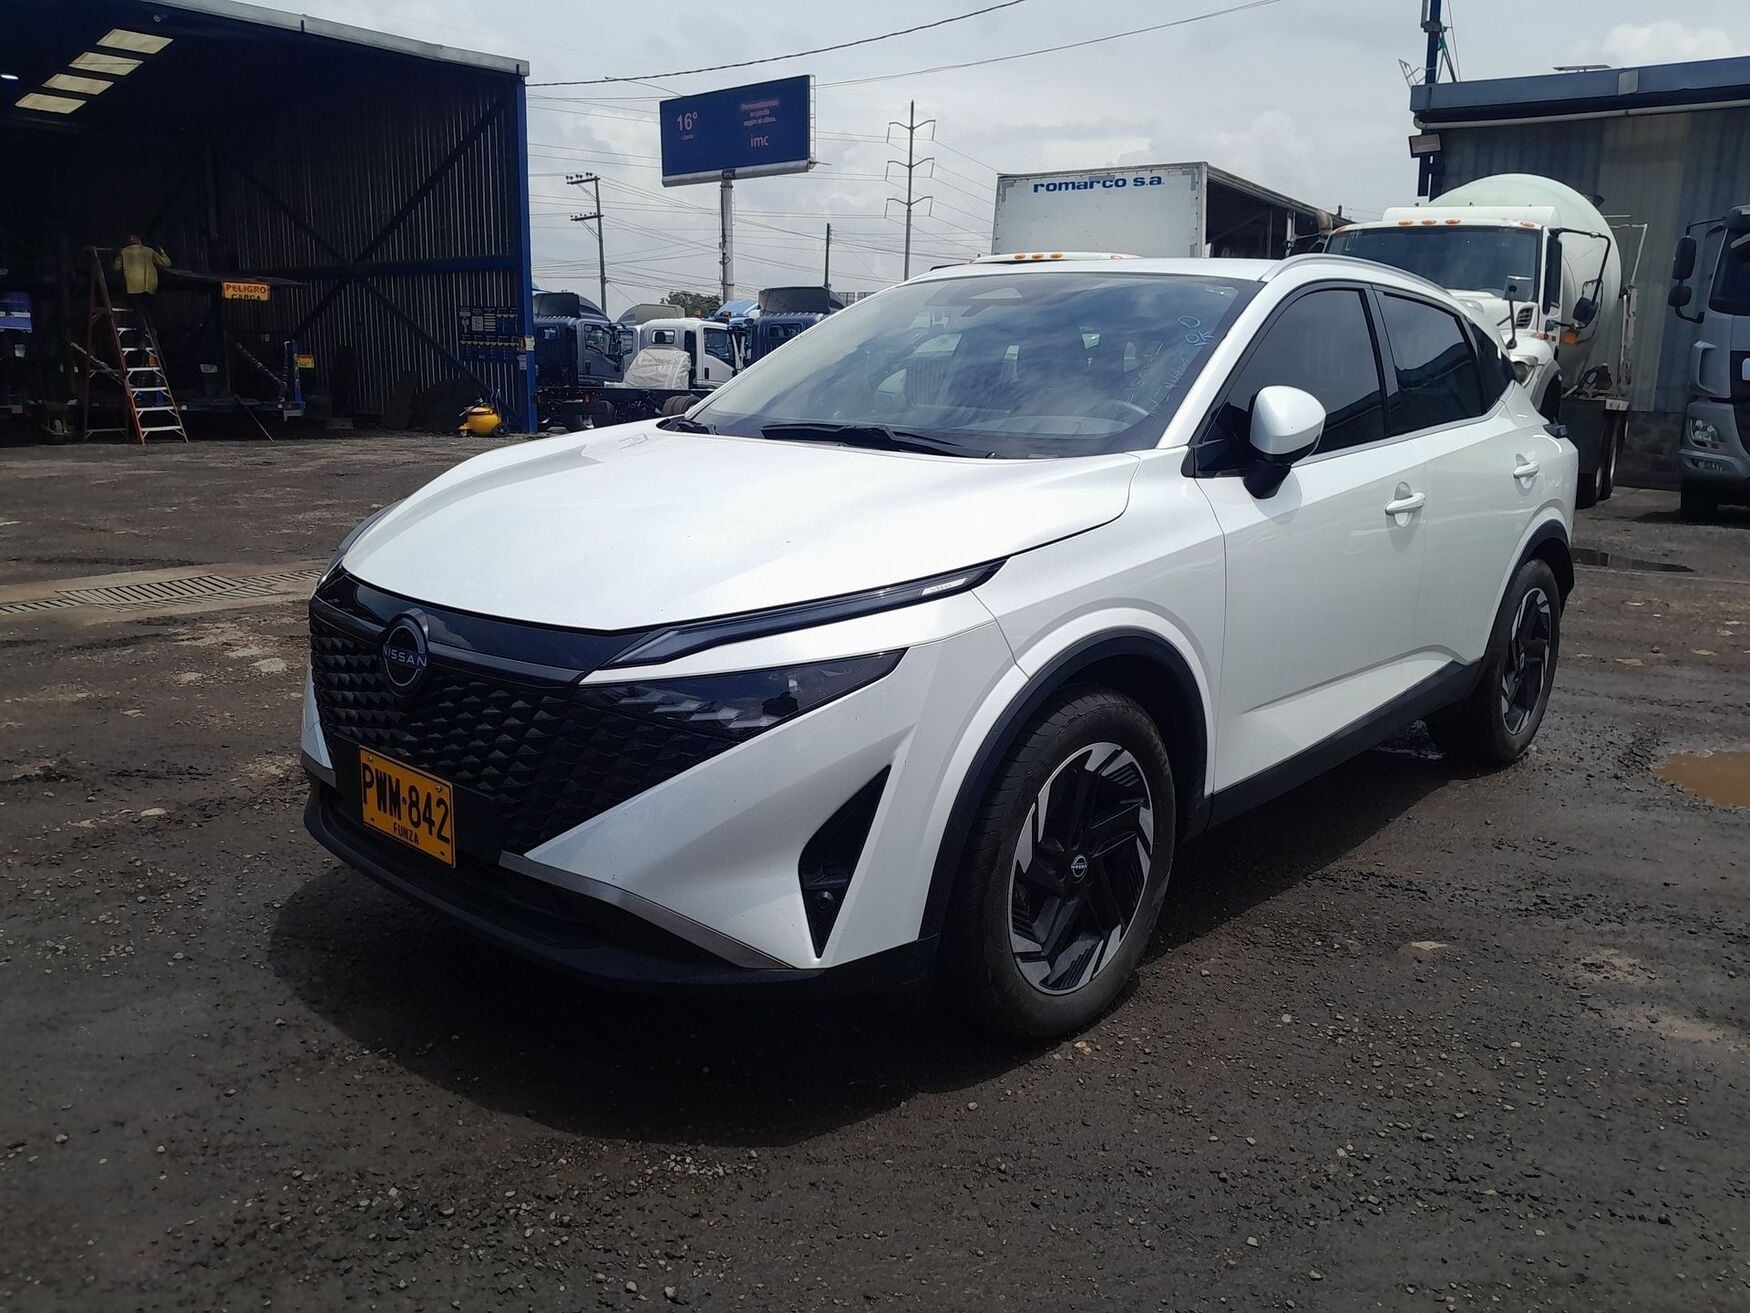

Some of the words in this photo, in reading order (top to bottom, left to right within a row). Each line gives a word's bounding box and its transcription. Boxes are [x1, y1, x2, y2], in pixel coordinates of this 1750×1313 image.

[677, 111, 698, 131] 16°
[751, 134, 770, 148] imc
[1033, 178, 1127, 193] romarco
[225, 284, 267, 295] PELIGRO
[383, 643, 428, 668] NISSAN
[393, 822, 419, 846] FUNZA
